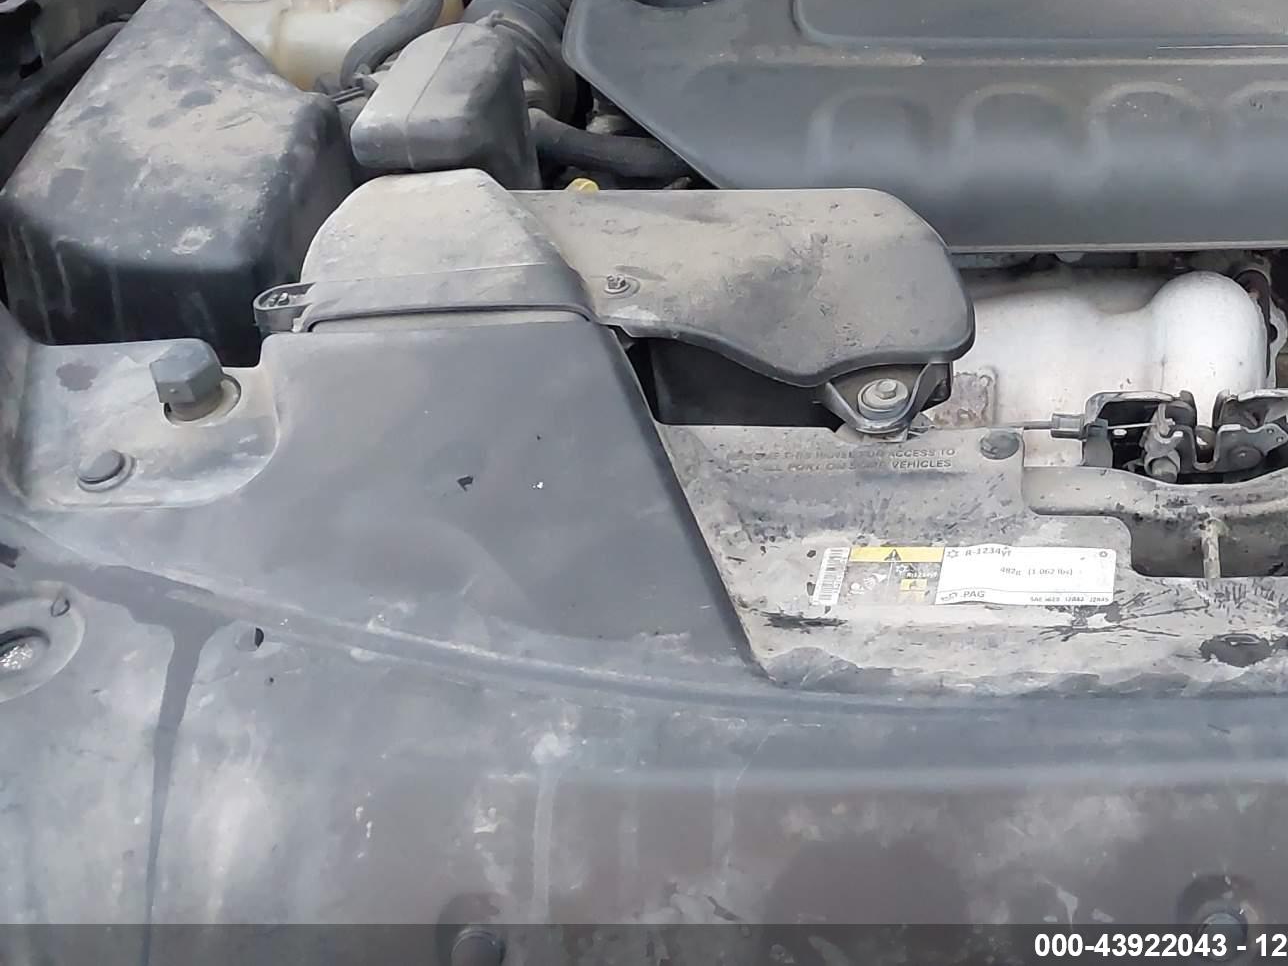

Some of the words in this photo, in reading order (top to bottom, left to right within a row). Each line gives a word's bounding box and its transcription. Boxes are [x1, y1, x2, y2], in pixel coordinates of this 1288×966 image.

[939, 449, 955, 457] TO
[892, 459, 951, 469] VEHICLES
[963, 590, 985, 598] PAG
